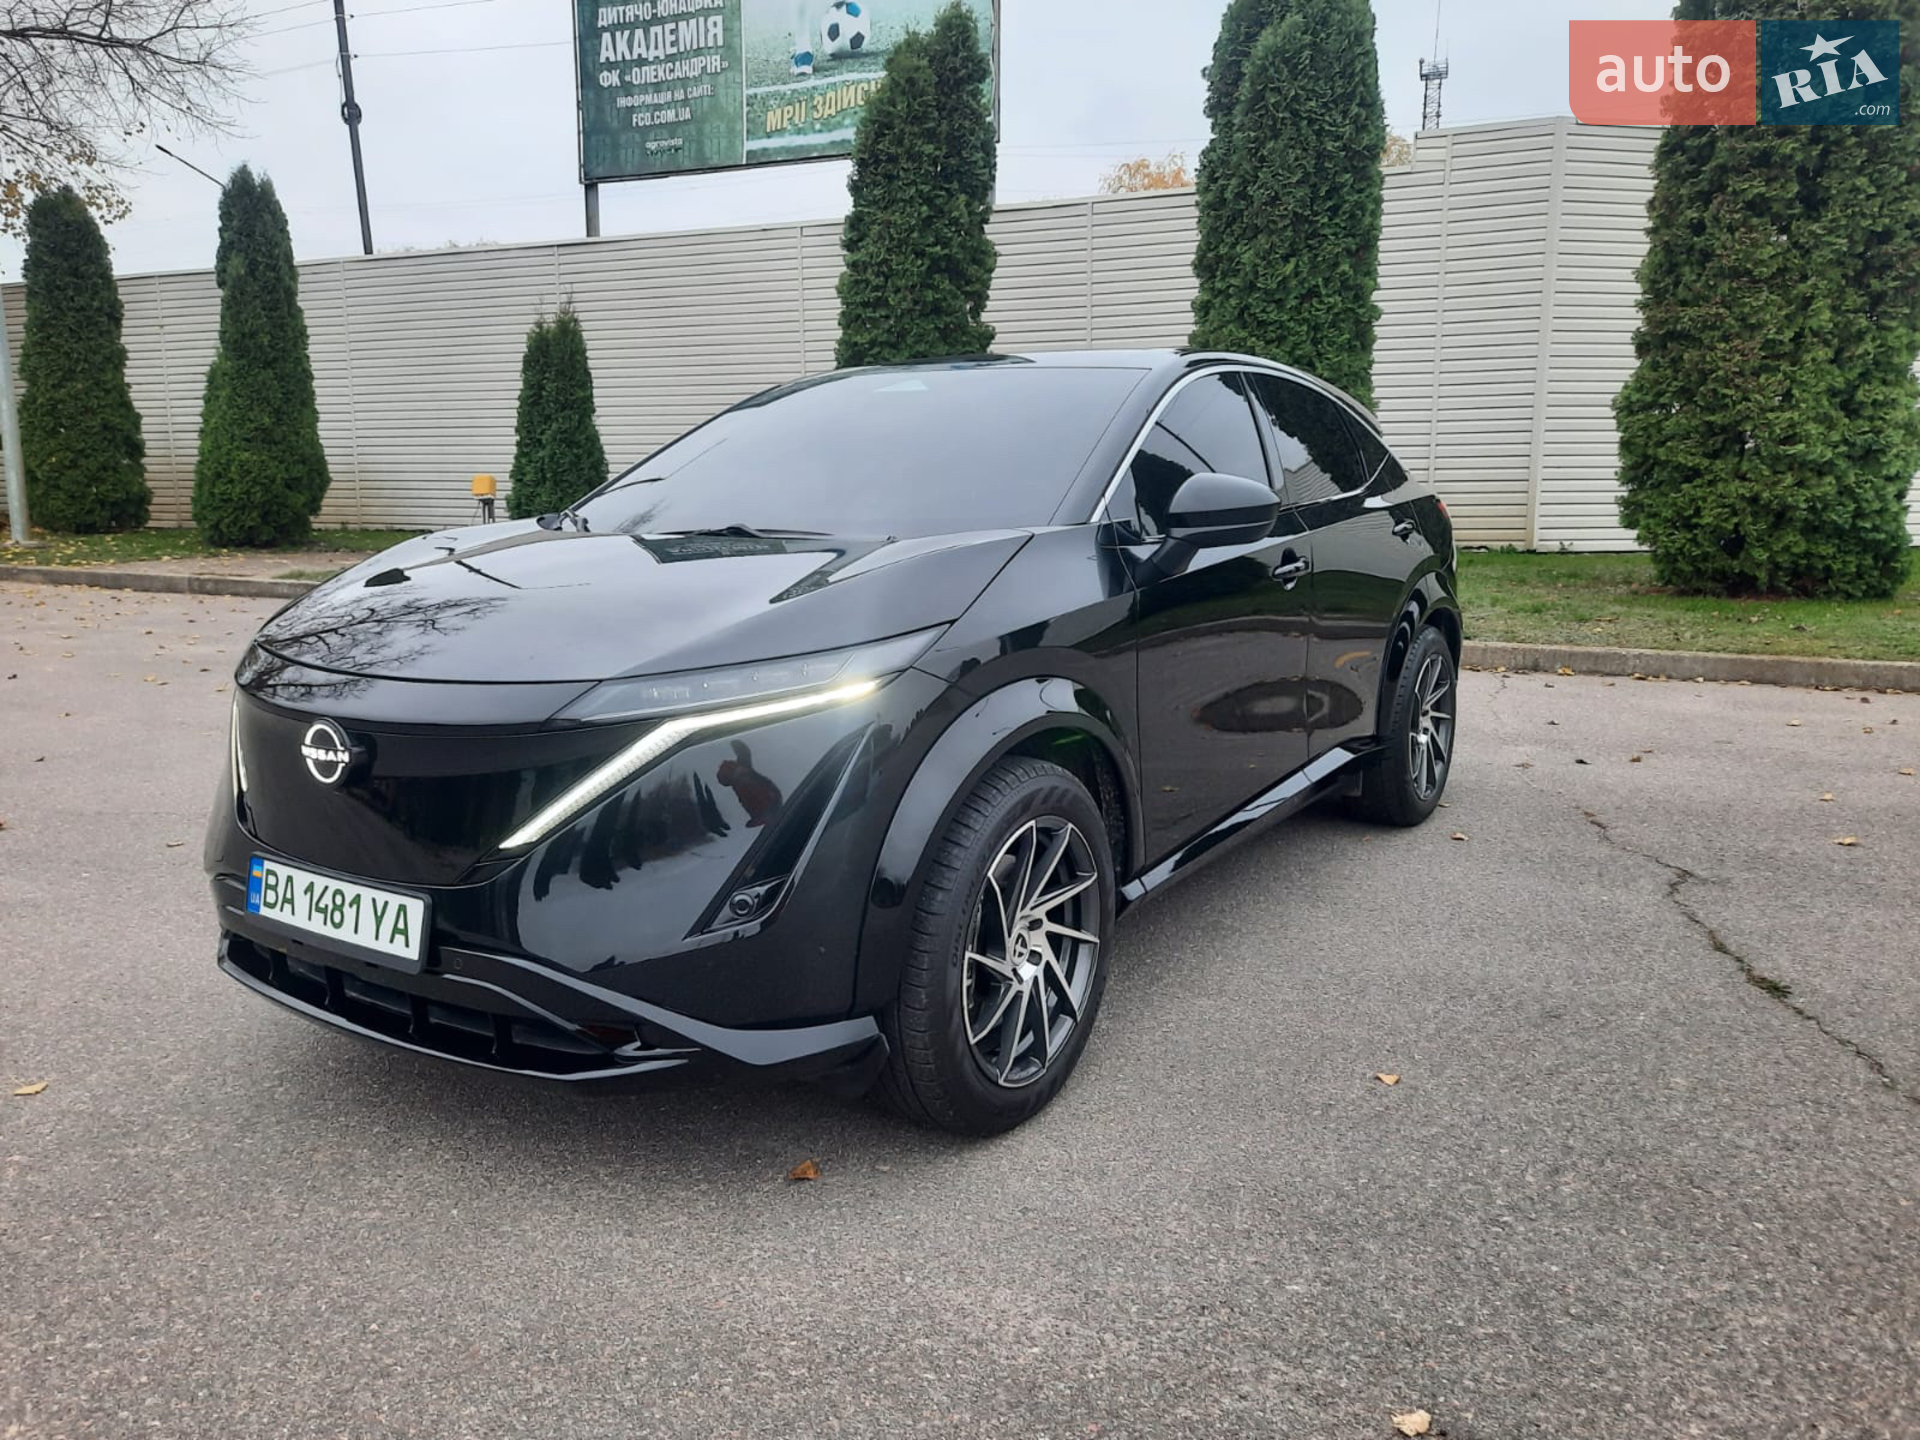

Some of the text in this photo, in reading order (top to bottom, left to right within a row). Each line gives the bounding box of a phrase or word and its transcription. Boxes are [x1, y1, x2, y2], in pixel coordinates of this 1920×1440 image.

[599, 15, 724, 63] АКАДЕМІЯ
[599, 54, 729, 88] ФК «ОЛЕКСАНДРІЯ»
[616, 91, 672, 108] ІНФОРМАЦІЯ
[673, 88, 685, 101] НА
[632, 107, 692, 127] FCO.COM.UA
[766, 96, 807, 133] МРІЇ
[250, 892, 260, 905] UA
